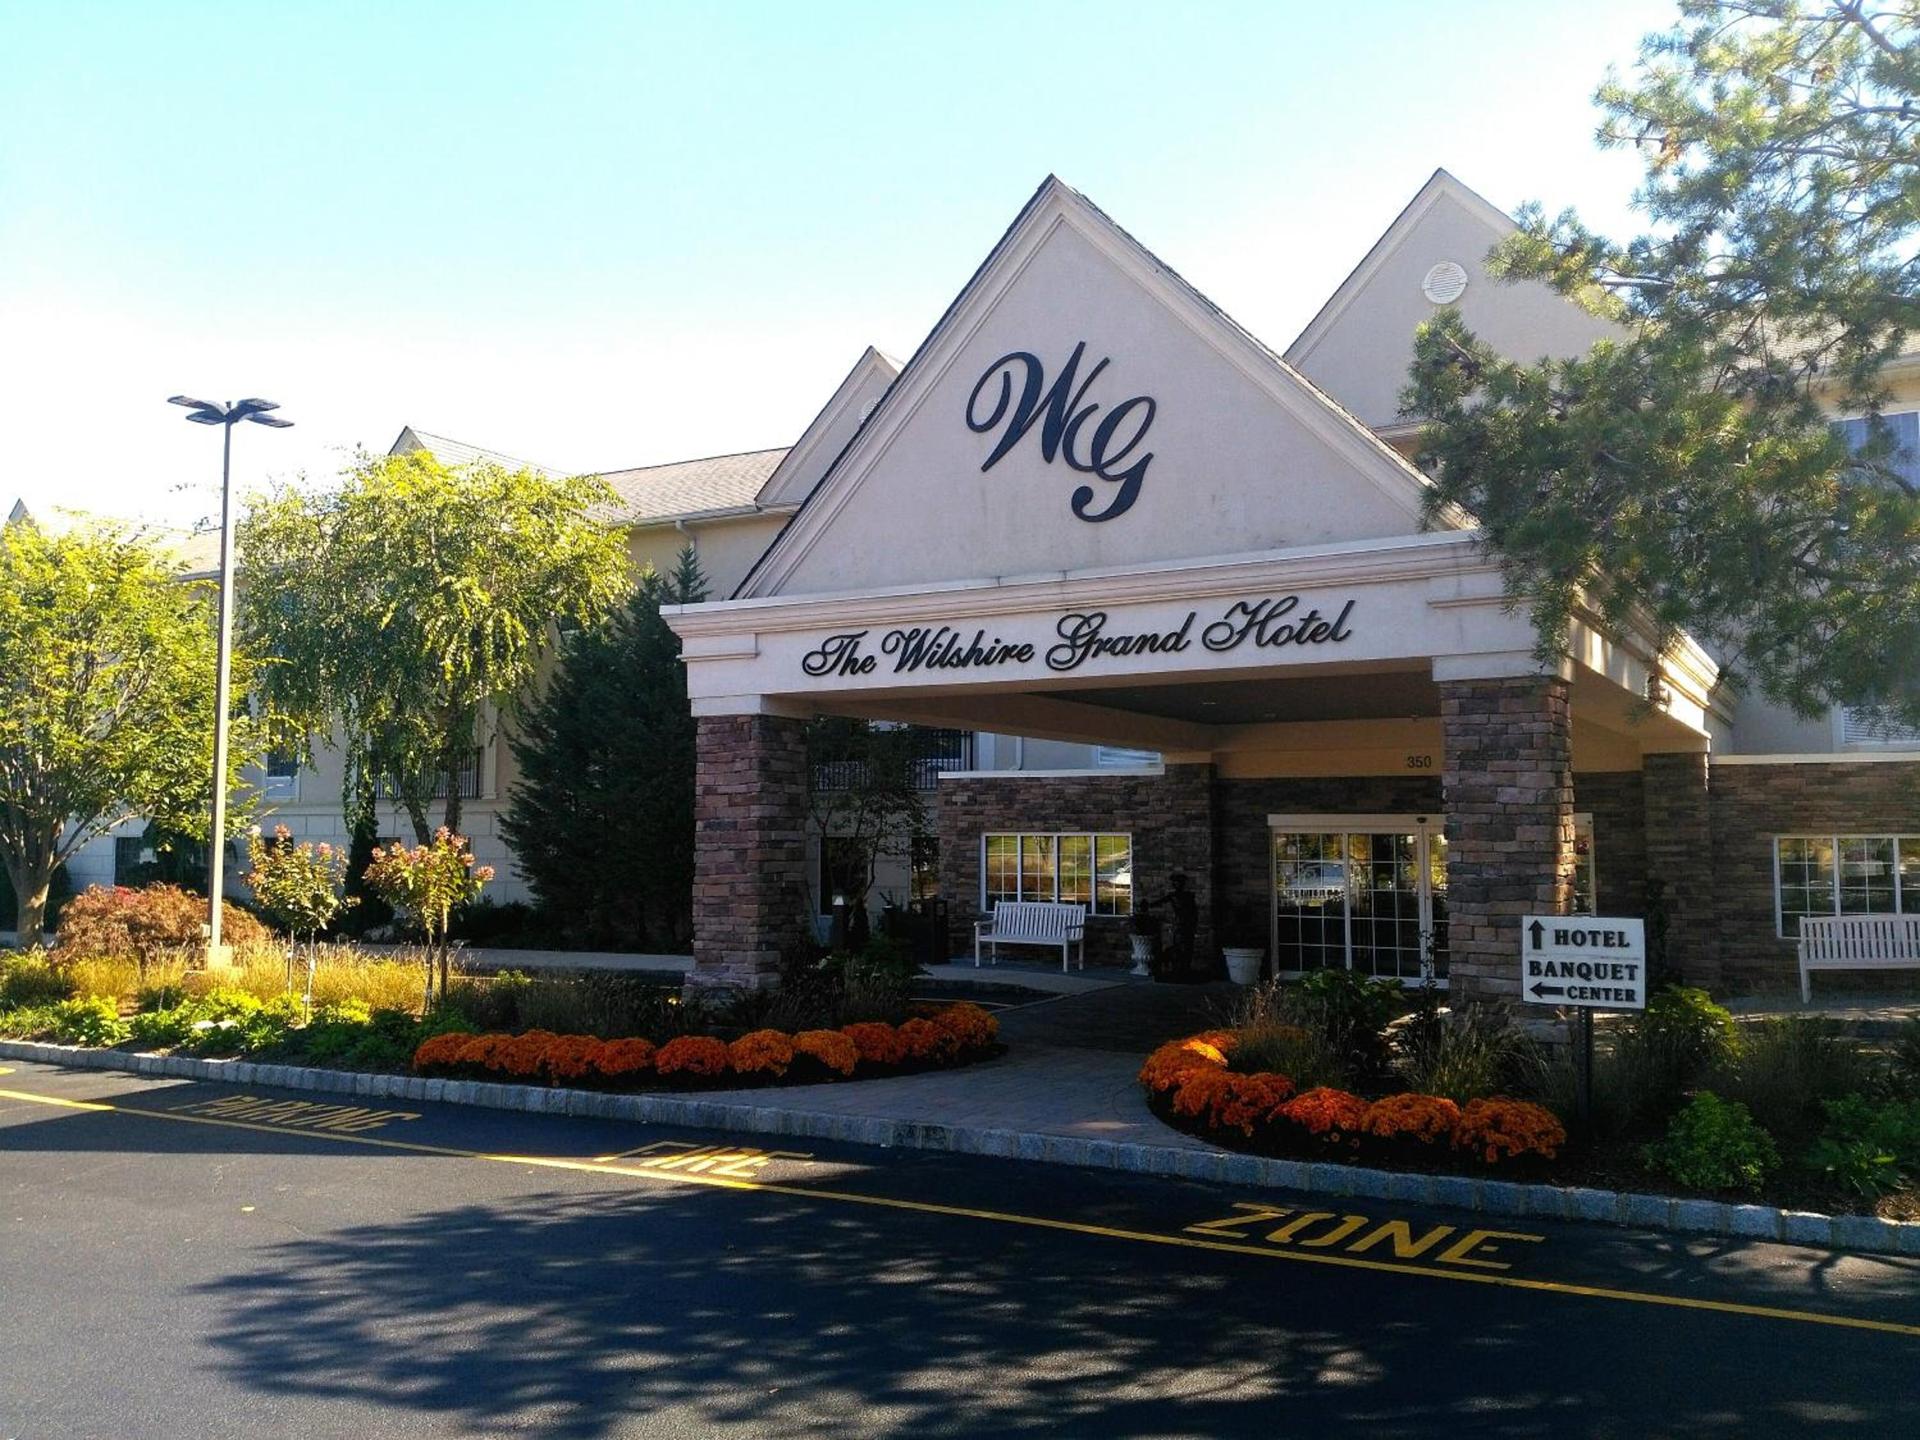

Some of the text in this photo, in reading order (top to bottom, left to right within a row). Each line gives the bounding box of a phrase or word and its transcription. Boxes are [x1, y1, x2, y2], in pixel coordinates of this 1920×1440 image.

[802, 595, 1356, 677] The Wilshire Grand Hotel
[1407, 755, 1432, 768] 350
[1554, 929, 1630, 948] HOTEL
[1528, 960, 1638, 982] BANQUET
[1567, 985, 1637, 1002] CENTER
[1181, 1202, 1546, 1269] ZONE
